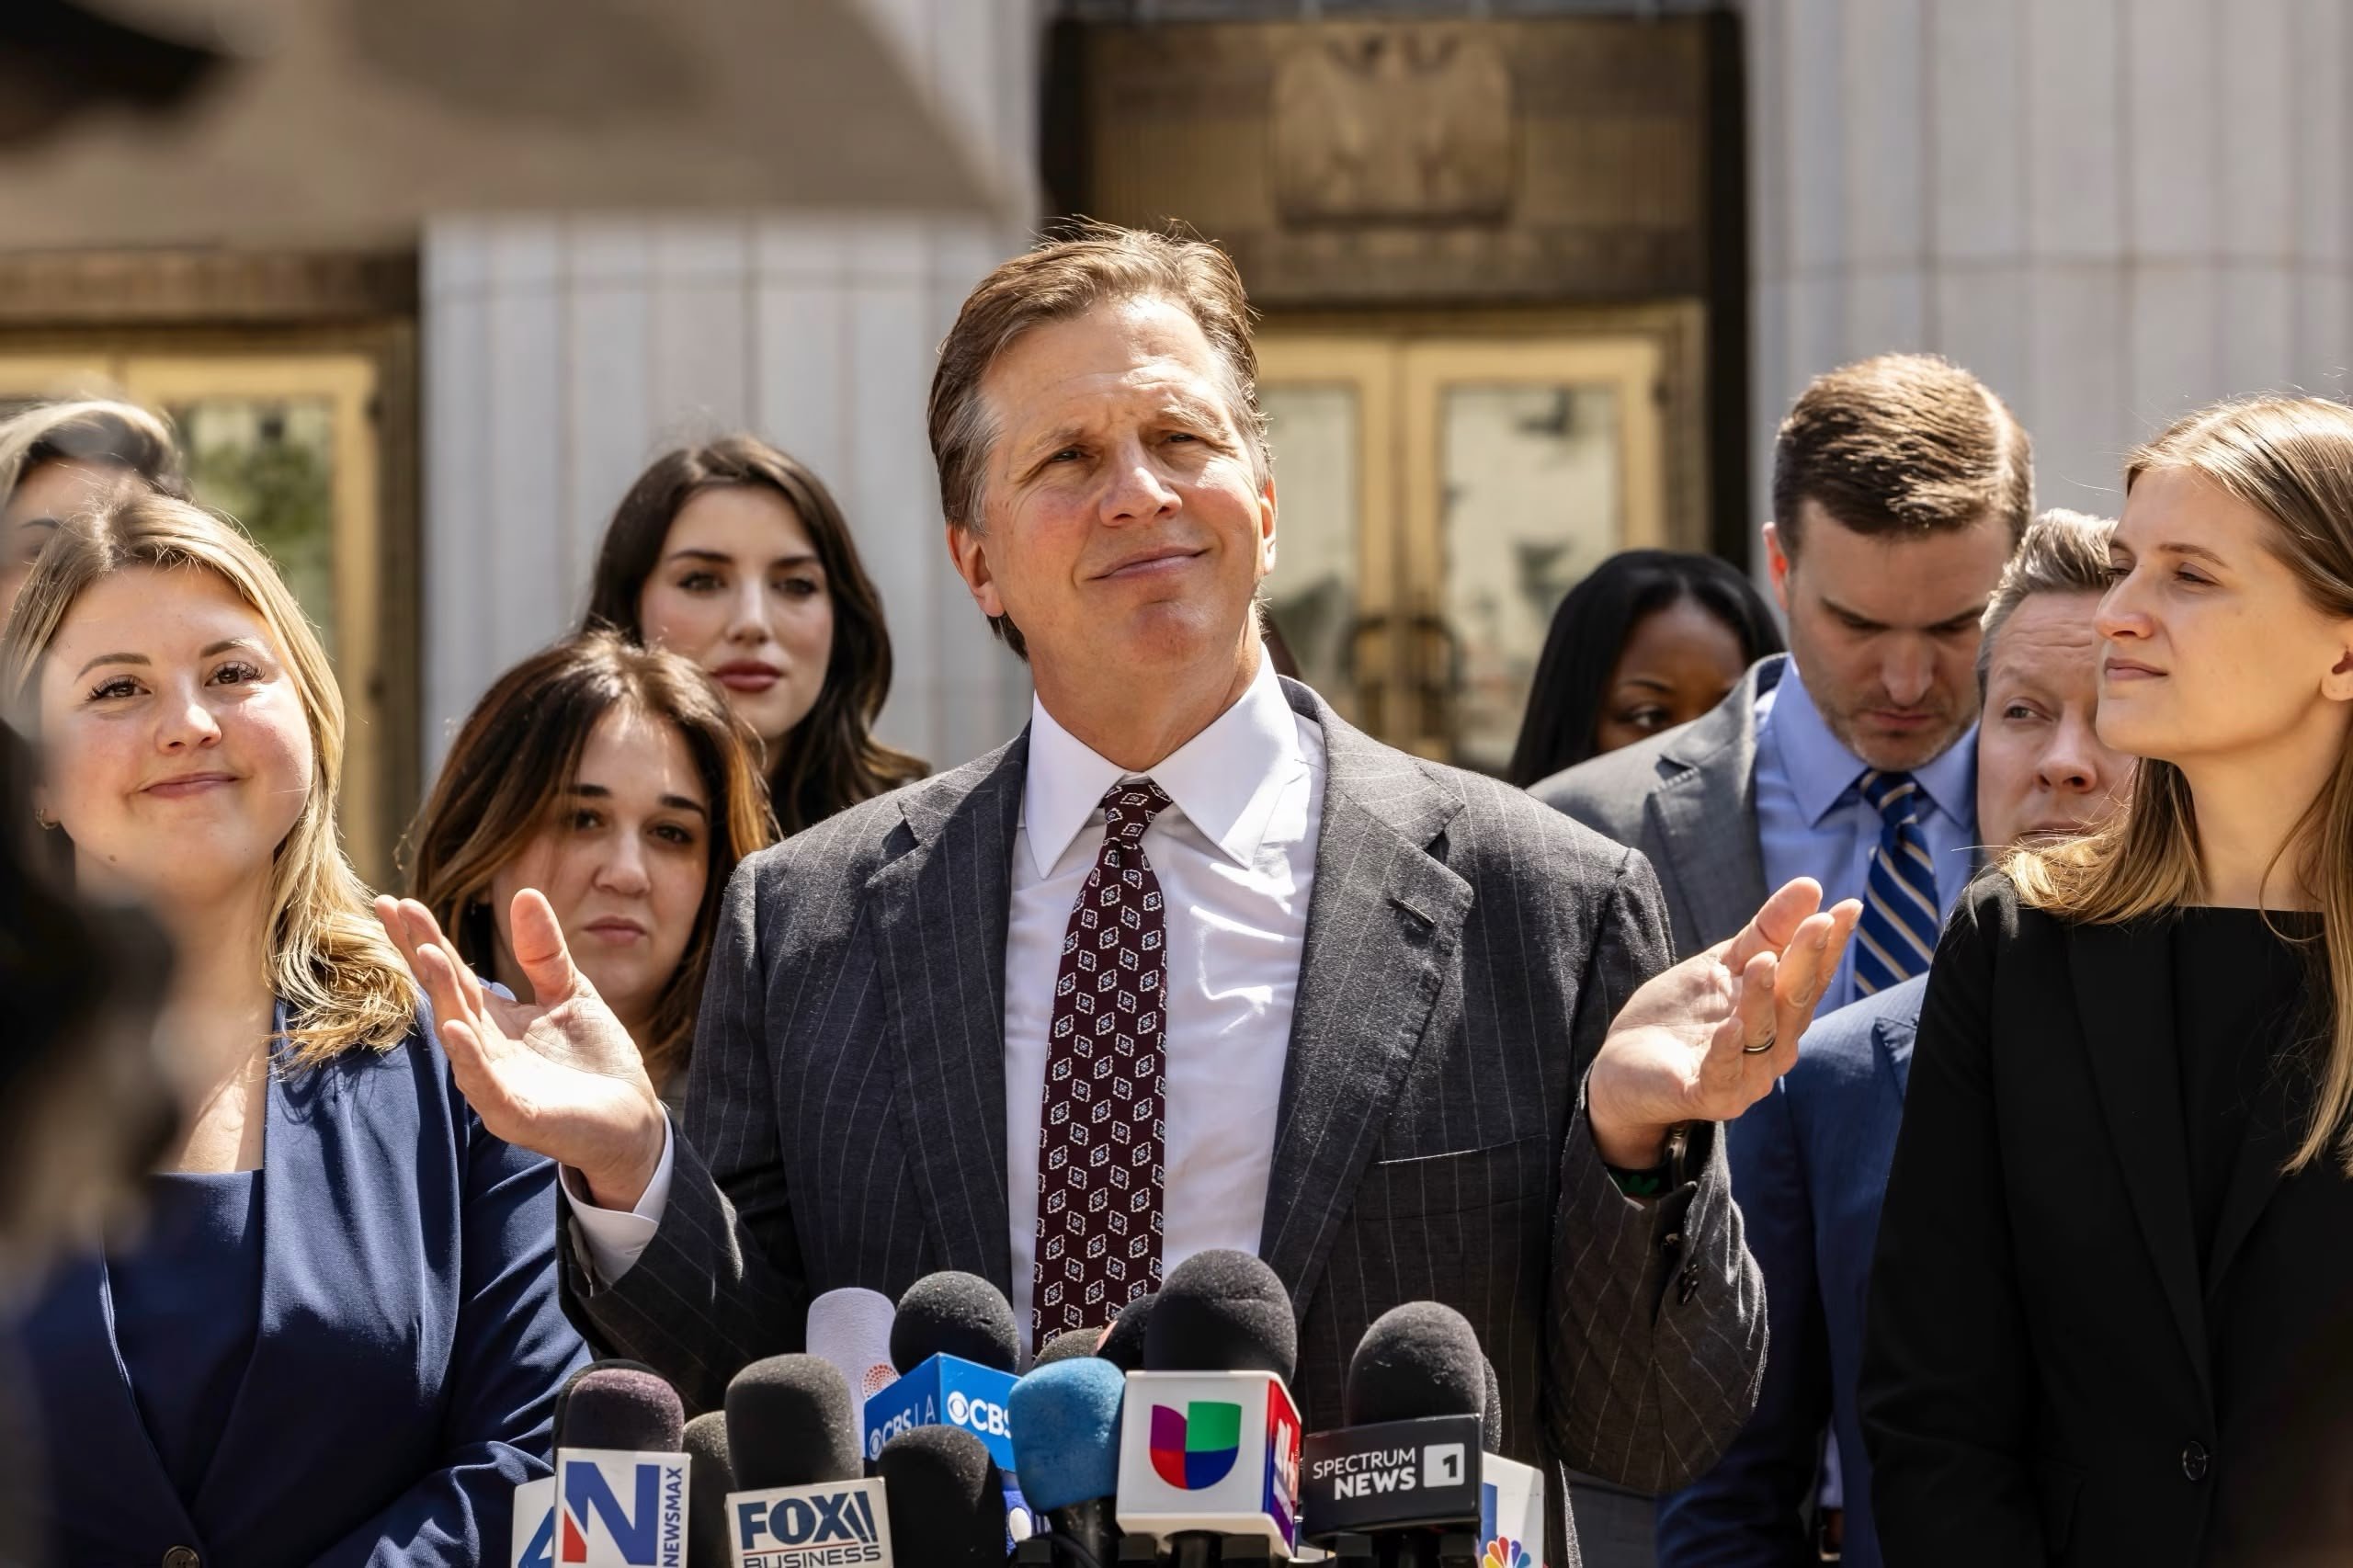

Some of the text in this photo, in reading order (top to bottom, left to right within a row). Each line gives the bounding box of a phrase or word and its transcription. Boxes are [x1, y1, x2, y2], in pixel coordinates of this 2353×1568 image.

[1313, 1447, 1415, 1479] SPECTRUM
[1442, 1454, 1458, 1479] 1
[1335, 1467, 1416, 1500] NEWS
[663, 1467, 682, 1568] NEWSMAX
[738, 1492, 856, 1550] FOX
[744, 1545, 881, 1568] BUSINESS
